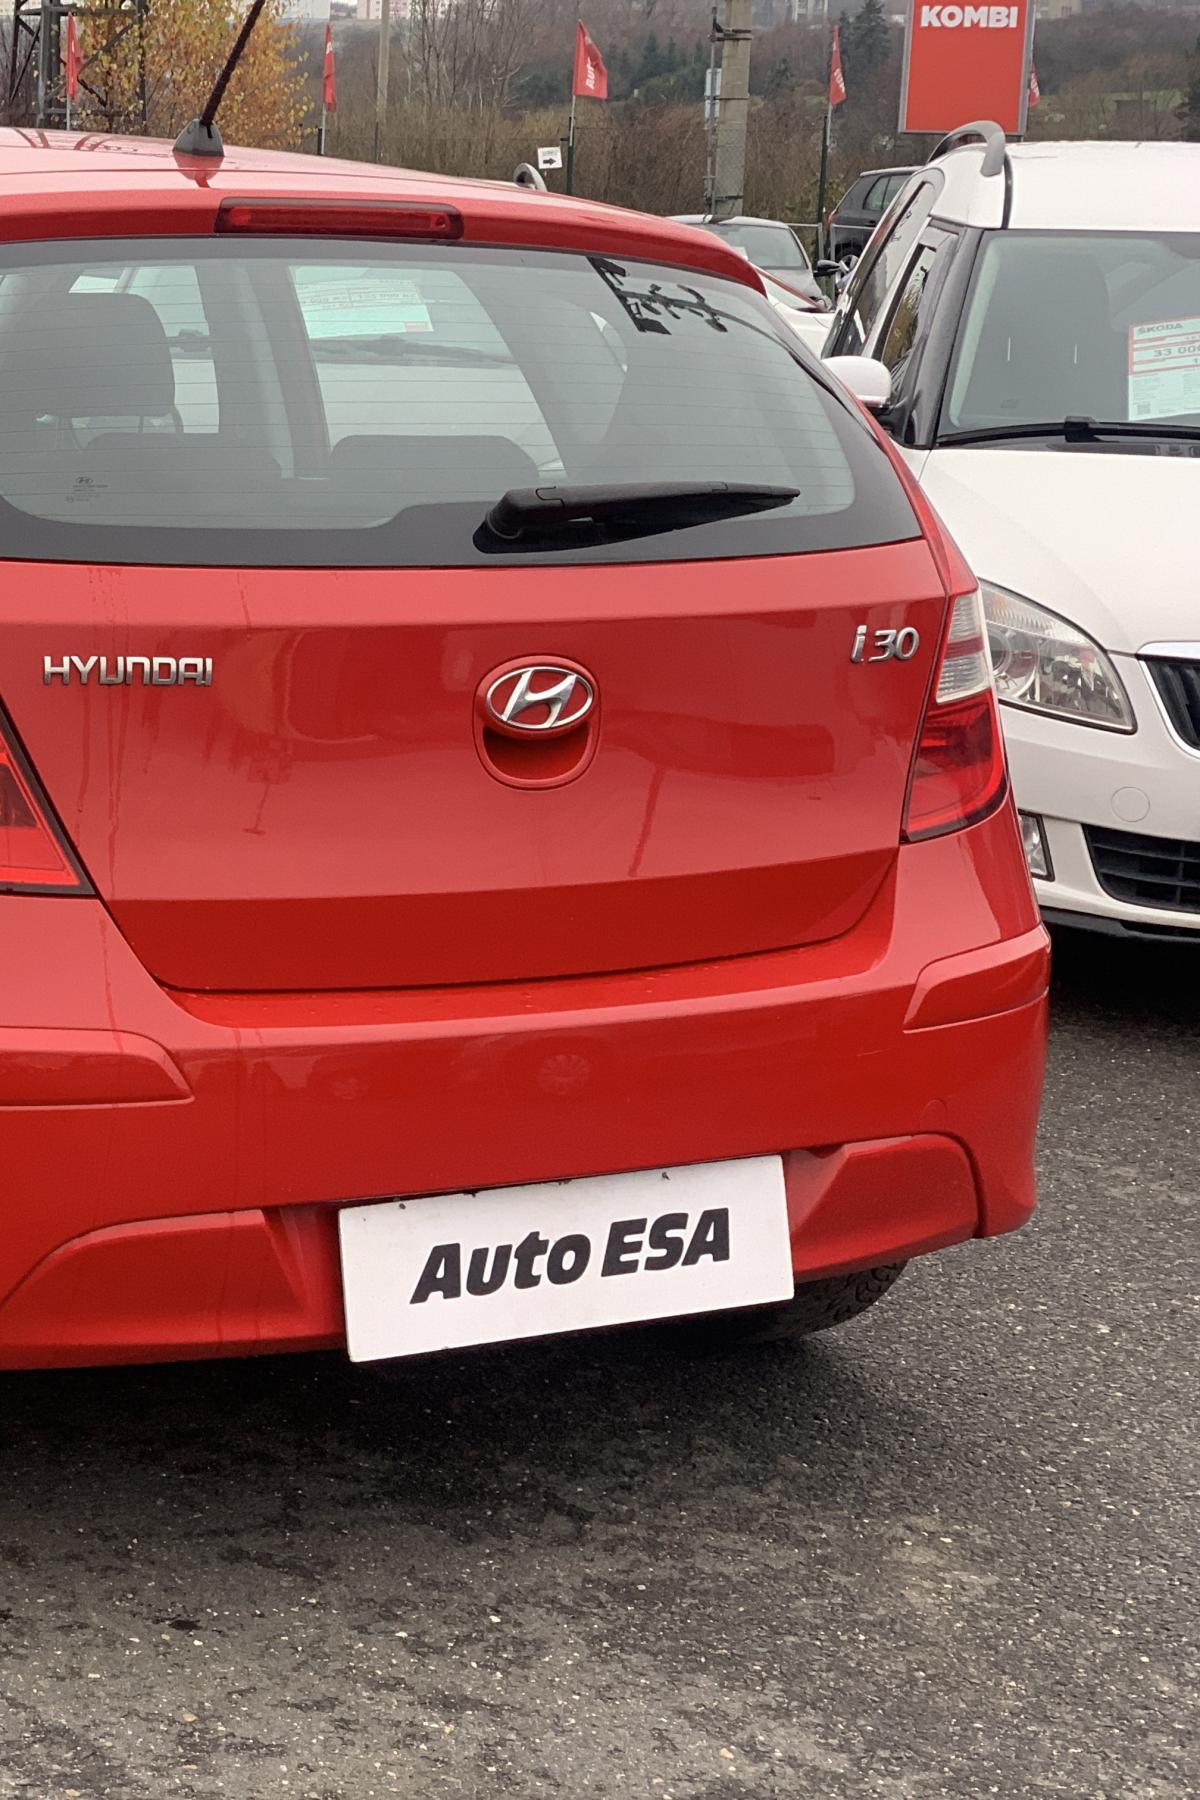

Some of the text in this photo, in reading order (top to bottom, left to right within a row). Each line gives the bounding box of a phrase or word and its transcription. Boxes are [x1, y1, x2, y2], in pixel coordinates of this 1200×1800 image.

[920, 5, 1018, 28] KOMBI
[1138, 322, 1183, 334] ŠKODA
[43, 655, 212, 685] HYUNDAI
[409, 1207, 730, 1304] Auto ESA
